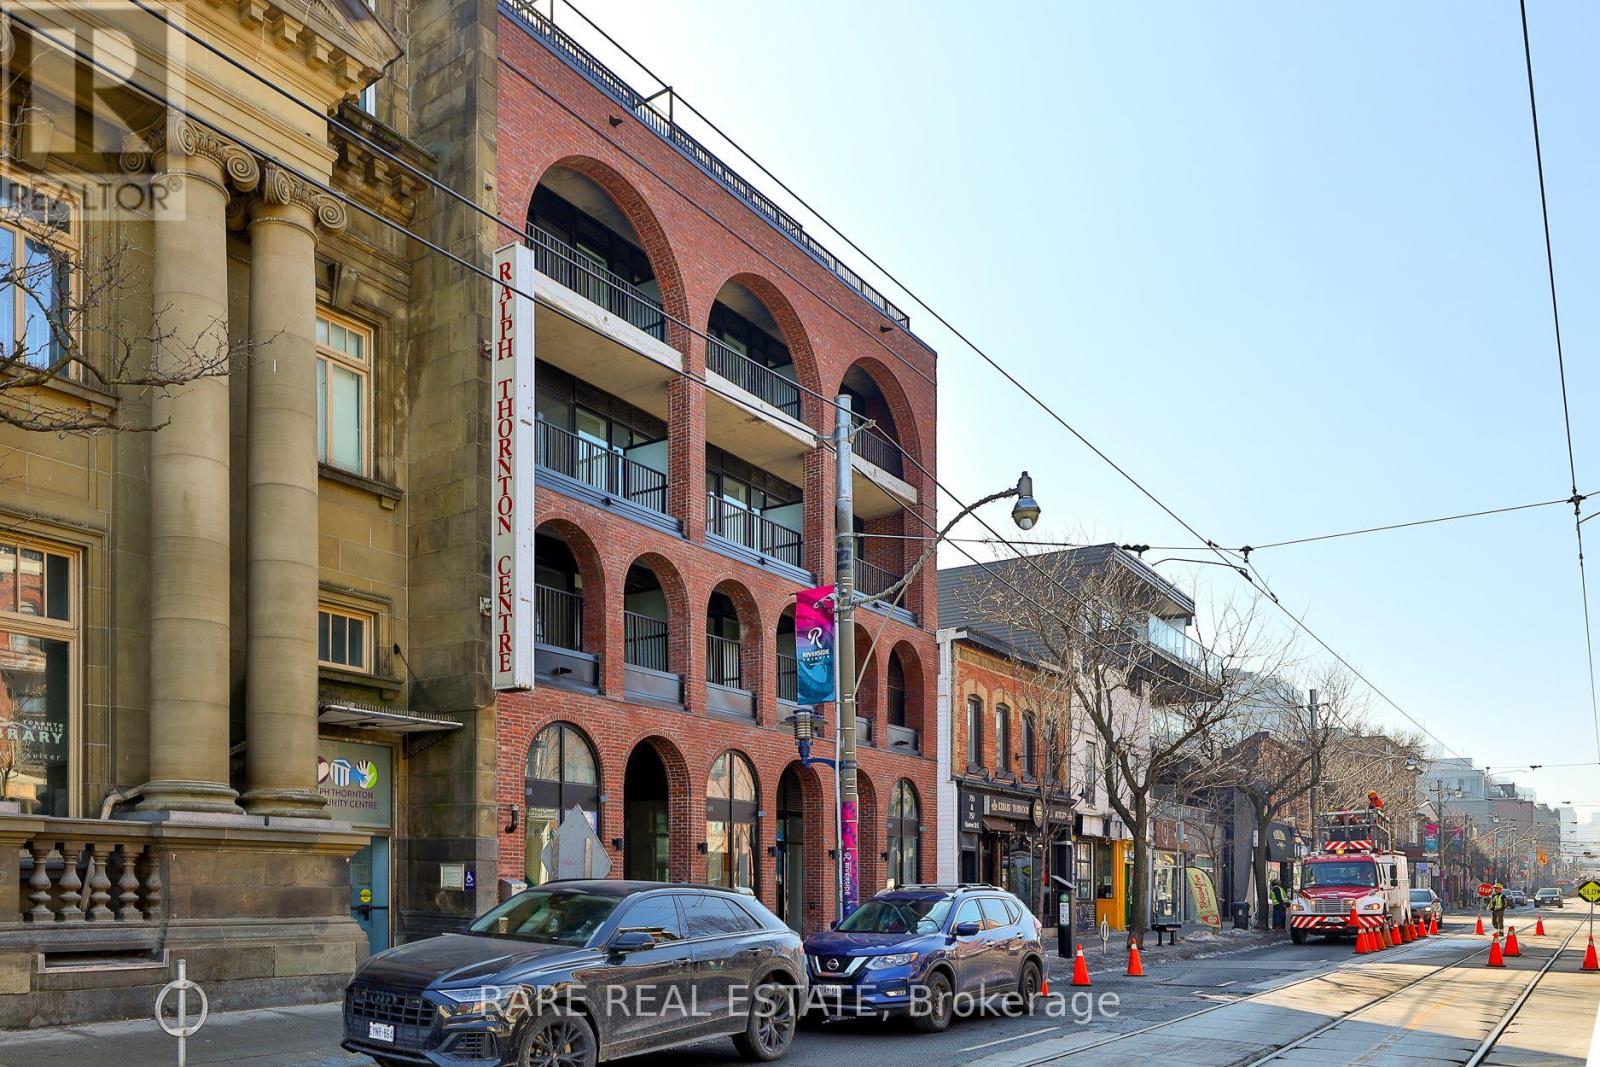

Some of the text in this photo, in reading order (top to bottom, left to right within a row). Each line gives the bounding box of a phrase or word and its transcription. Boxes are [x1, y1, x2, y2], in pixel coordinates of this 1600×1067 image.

[496, 261, 514, 673] RALPH THORNTON CENTRE
[802, 649, 830, 658] RIVERSIDE
[22, 719, 64, 728] TORONTO
[32, 725, 64, 733] PUBLIC
[332, 789, 374, 799] THORNTON
[350, 801, 378, 809] CENTRE
[844, 862, 852, 896] RIVERSIDE
